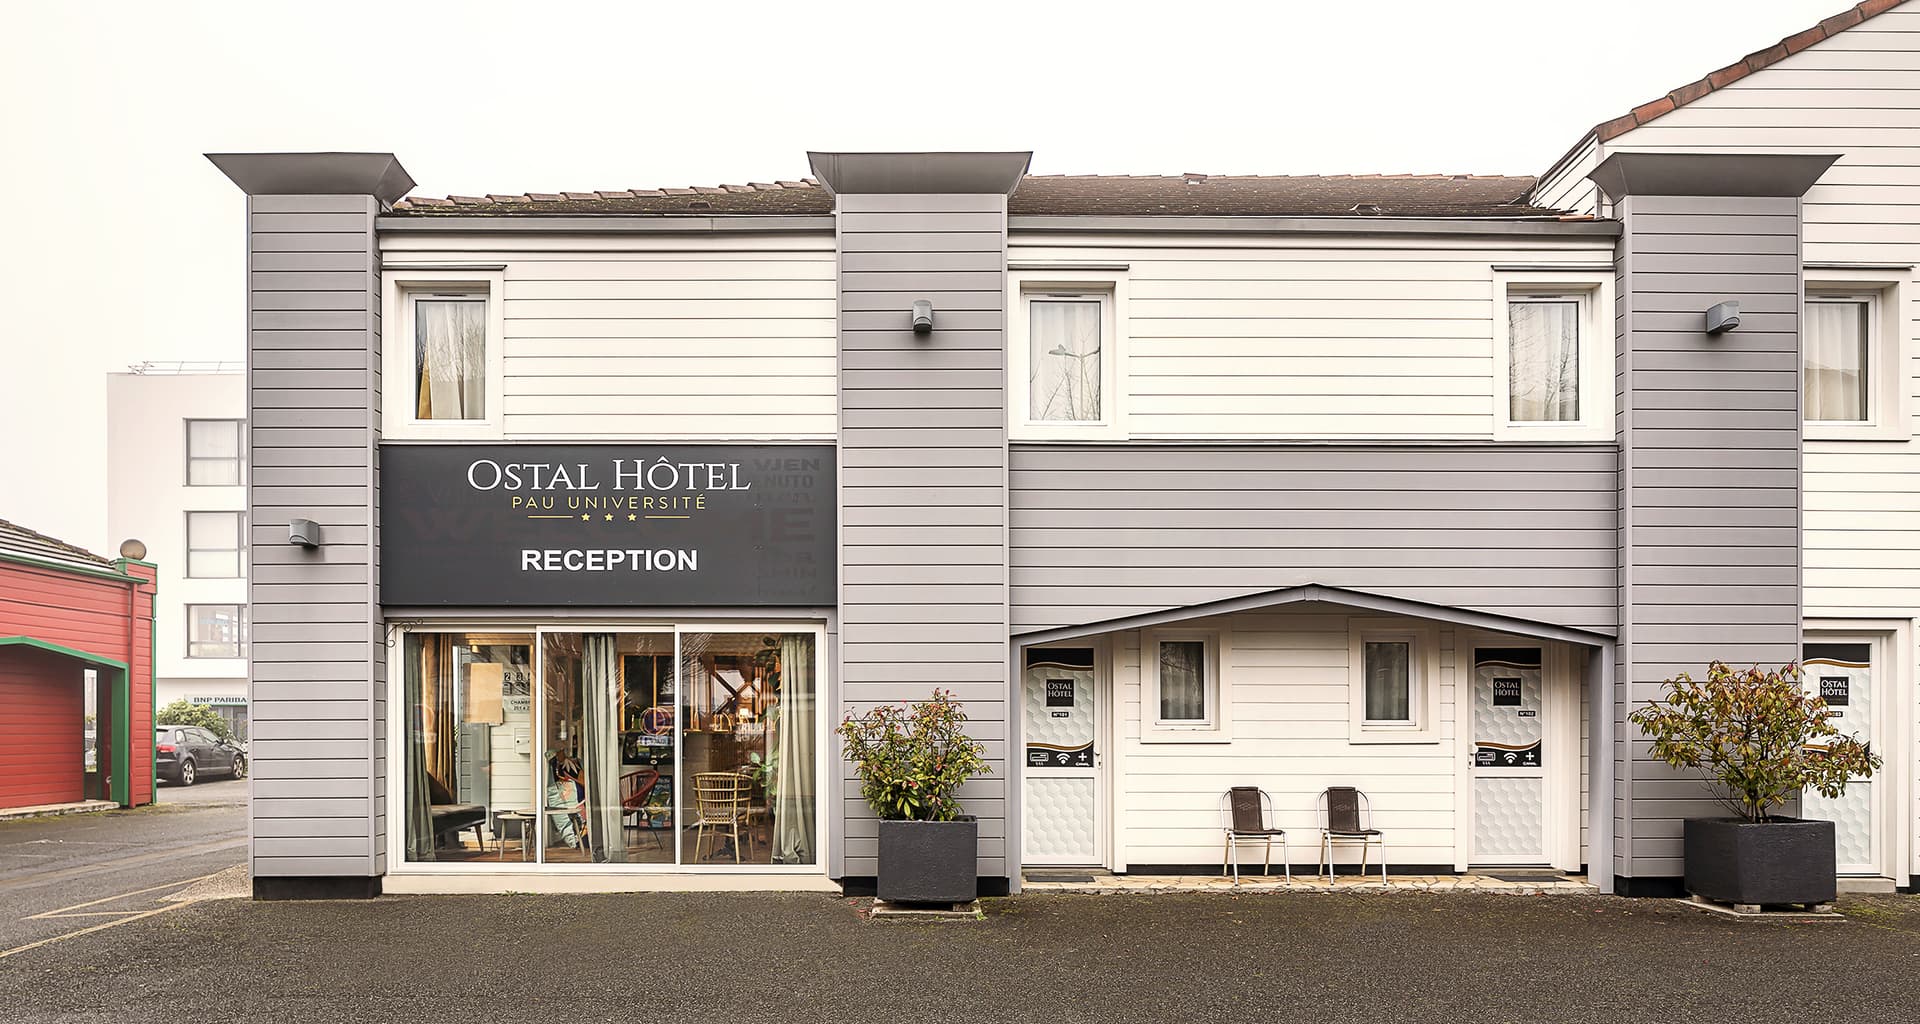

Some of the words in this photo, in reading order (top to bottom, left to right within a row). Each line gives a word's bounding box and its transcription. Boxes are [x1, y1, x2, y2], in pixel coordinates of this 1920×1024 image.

[468, 459, 599, 491] OSTAL
[613, 456, 751, 491] HÔTEL
[512, 496, 554, 510] PAU
[568, 493, 706, 510] UNIVERSITÉ
[521, 549, 698, 571] RECEPTION
[1047, 682, 1072, 690] OSTAL
[1494, 681, 1519, 689] OSTAL
[1821, 680, 1848, 688] OSTAL
[1821, 687, 1848, 696] HÔTEL
